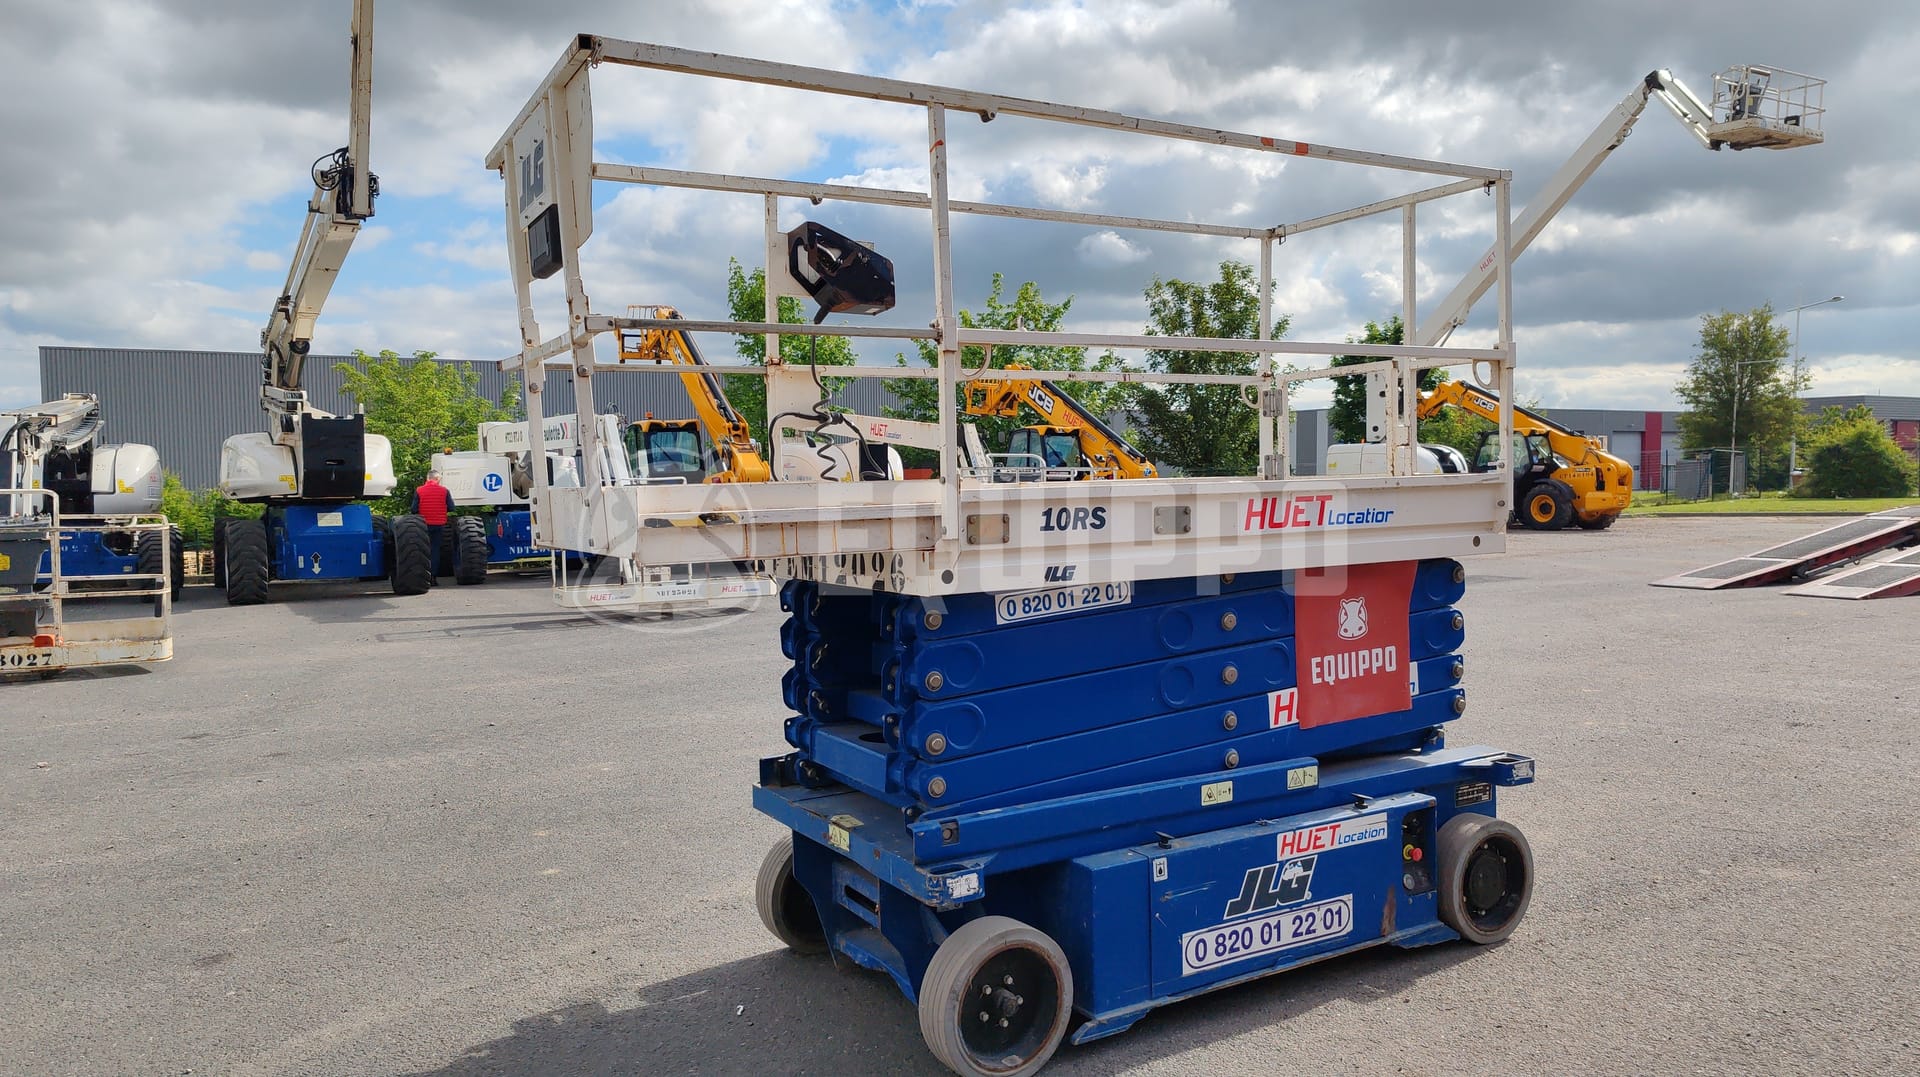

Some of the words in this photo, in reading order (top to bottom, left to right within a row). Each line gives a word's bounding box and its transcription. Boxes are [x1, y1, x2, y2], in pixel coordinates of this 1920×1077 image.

[1028, 386, 1055, 412] JCB
[1473, 397, 1495, 411] JCB
[869, 423, 888, 437] HUET
[1040, 506, 1107, 532] 10RS
[1245, 494, 1333, 531] HUET
[590, 593, 612, 601] HUET
[722, 585, 743, 593] HUET
[1006, 599, 1016, 617] 0
[1022, 593, 1052, 615] 820
[1057, 589, 1075, 609] 01
[1081, 586, 1101, 605] 22
[1105, 582, 1122, 601] 01
[1311, 645, 1397, 686] EQUIPPO
[1280, 824, 1341, 857] HUET
[1338, 827, 1385, 844] Location
[1223, 855, 1318, 920] JLG
[1194, 938, 1208, 962] 0
[1214, 926, 1253, 957] 820
[1260, 918, 1281, 945] 01
[1292, 911, 1316, 938] 22
[1322, 905, 1342, 930] 01
